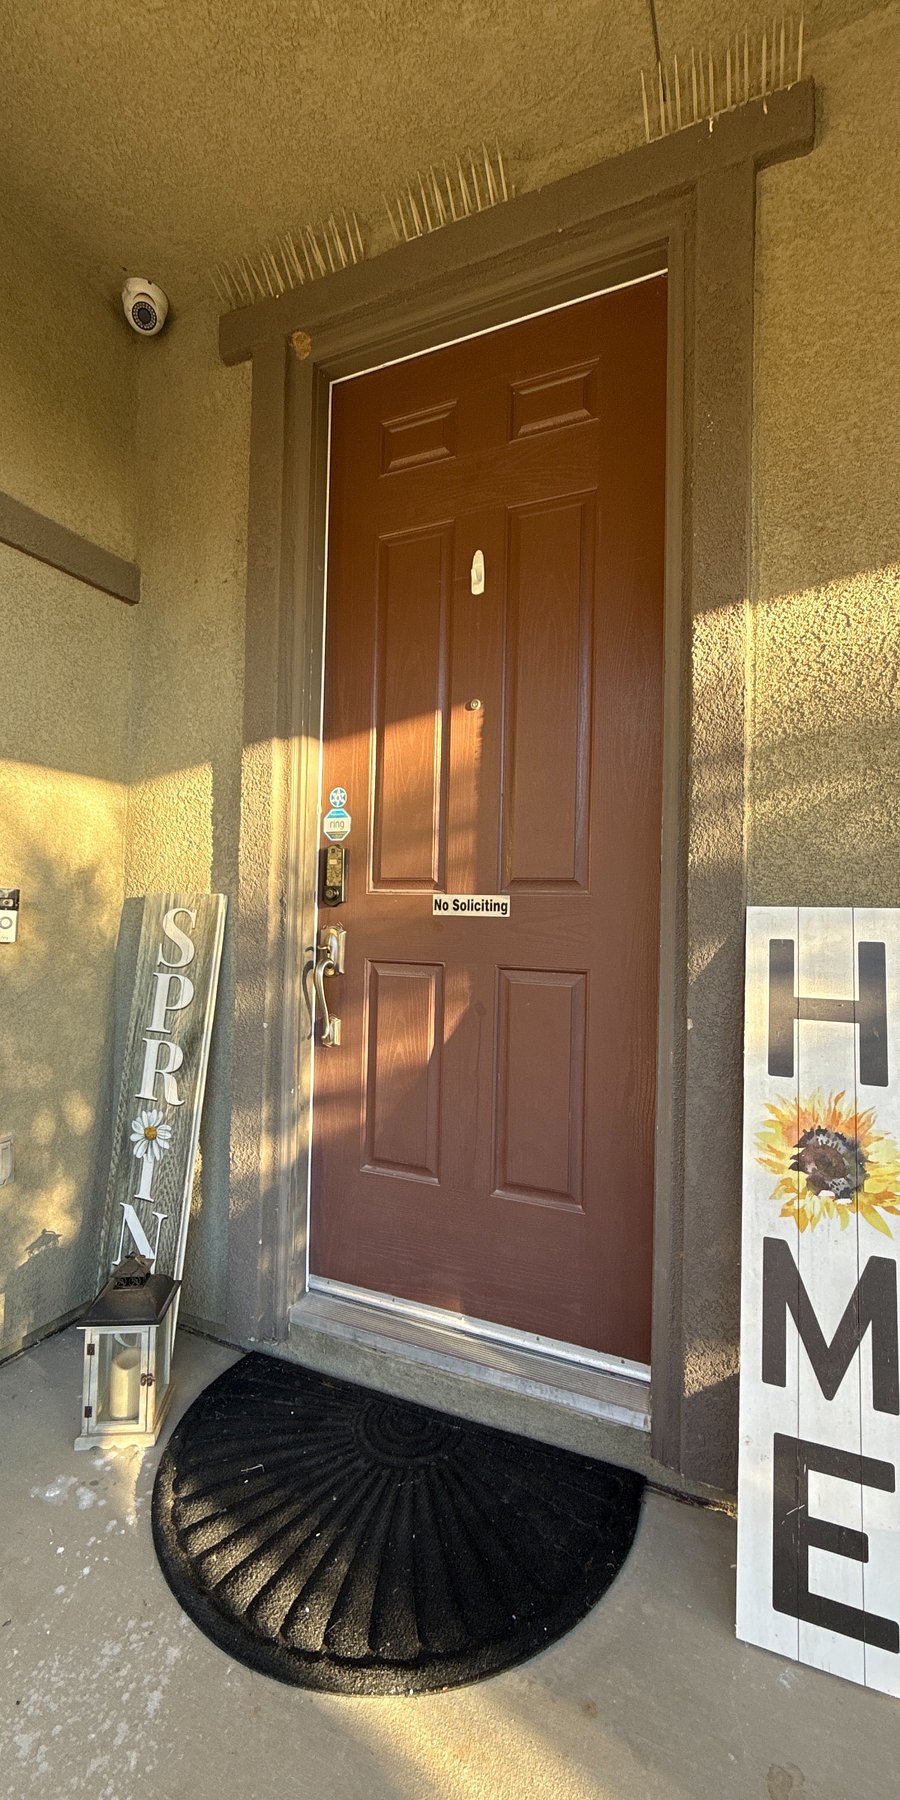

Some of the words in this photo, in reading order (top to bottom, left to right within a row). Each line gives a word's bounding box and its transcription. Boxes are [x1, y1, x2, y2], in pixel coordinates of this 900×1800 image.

[329, 820, 345, 830] ring
[434, 898, 449, 911] No
[452, 898, 508, 915] Soliciting
[111, 907, 198, 1347] SPRIN
